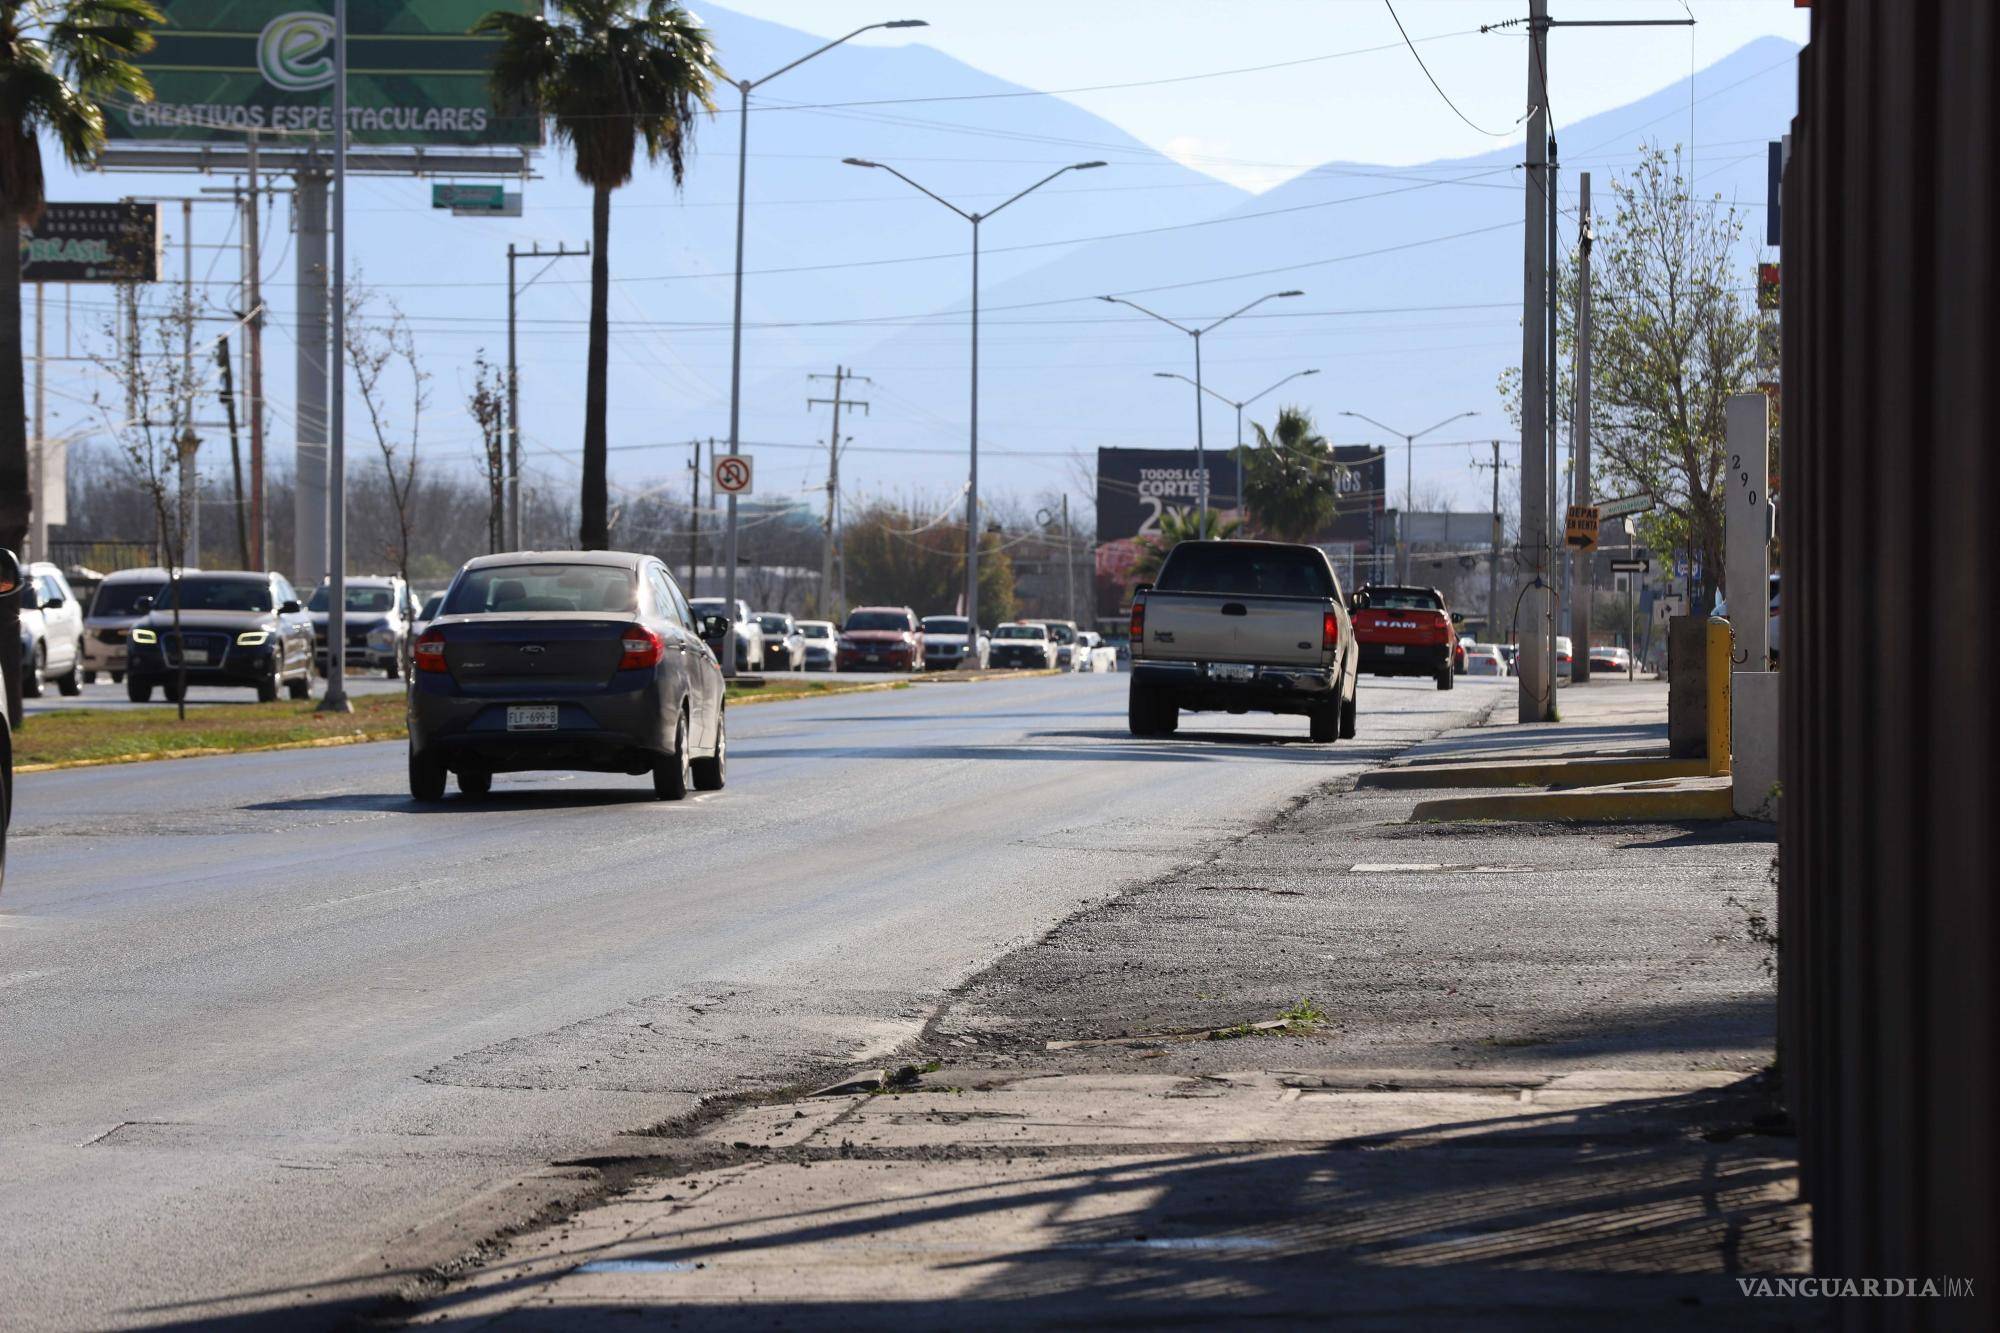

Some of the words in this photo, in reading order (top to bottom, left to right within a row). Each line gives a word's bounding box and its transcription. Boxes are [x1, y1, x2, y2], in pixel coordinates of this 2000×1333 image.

[1140, 469, 1183, 480] TODOS
[1185, 469, 1210, 480] LOS
[1138, 481, 1210, 496] CORTES
[1569, 507, 1598, 518] DEPAS
[1567, 519, 1576, 529] EN
[1577, 519, 1598, 530] VENTA
[1375, 620, 1416, 629] RAM
